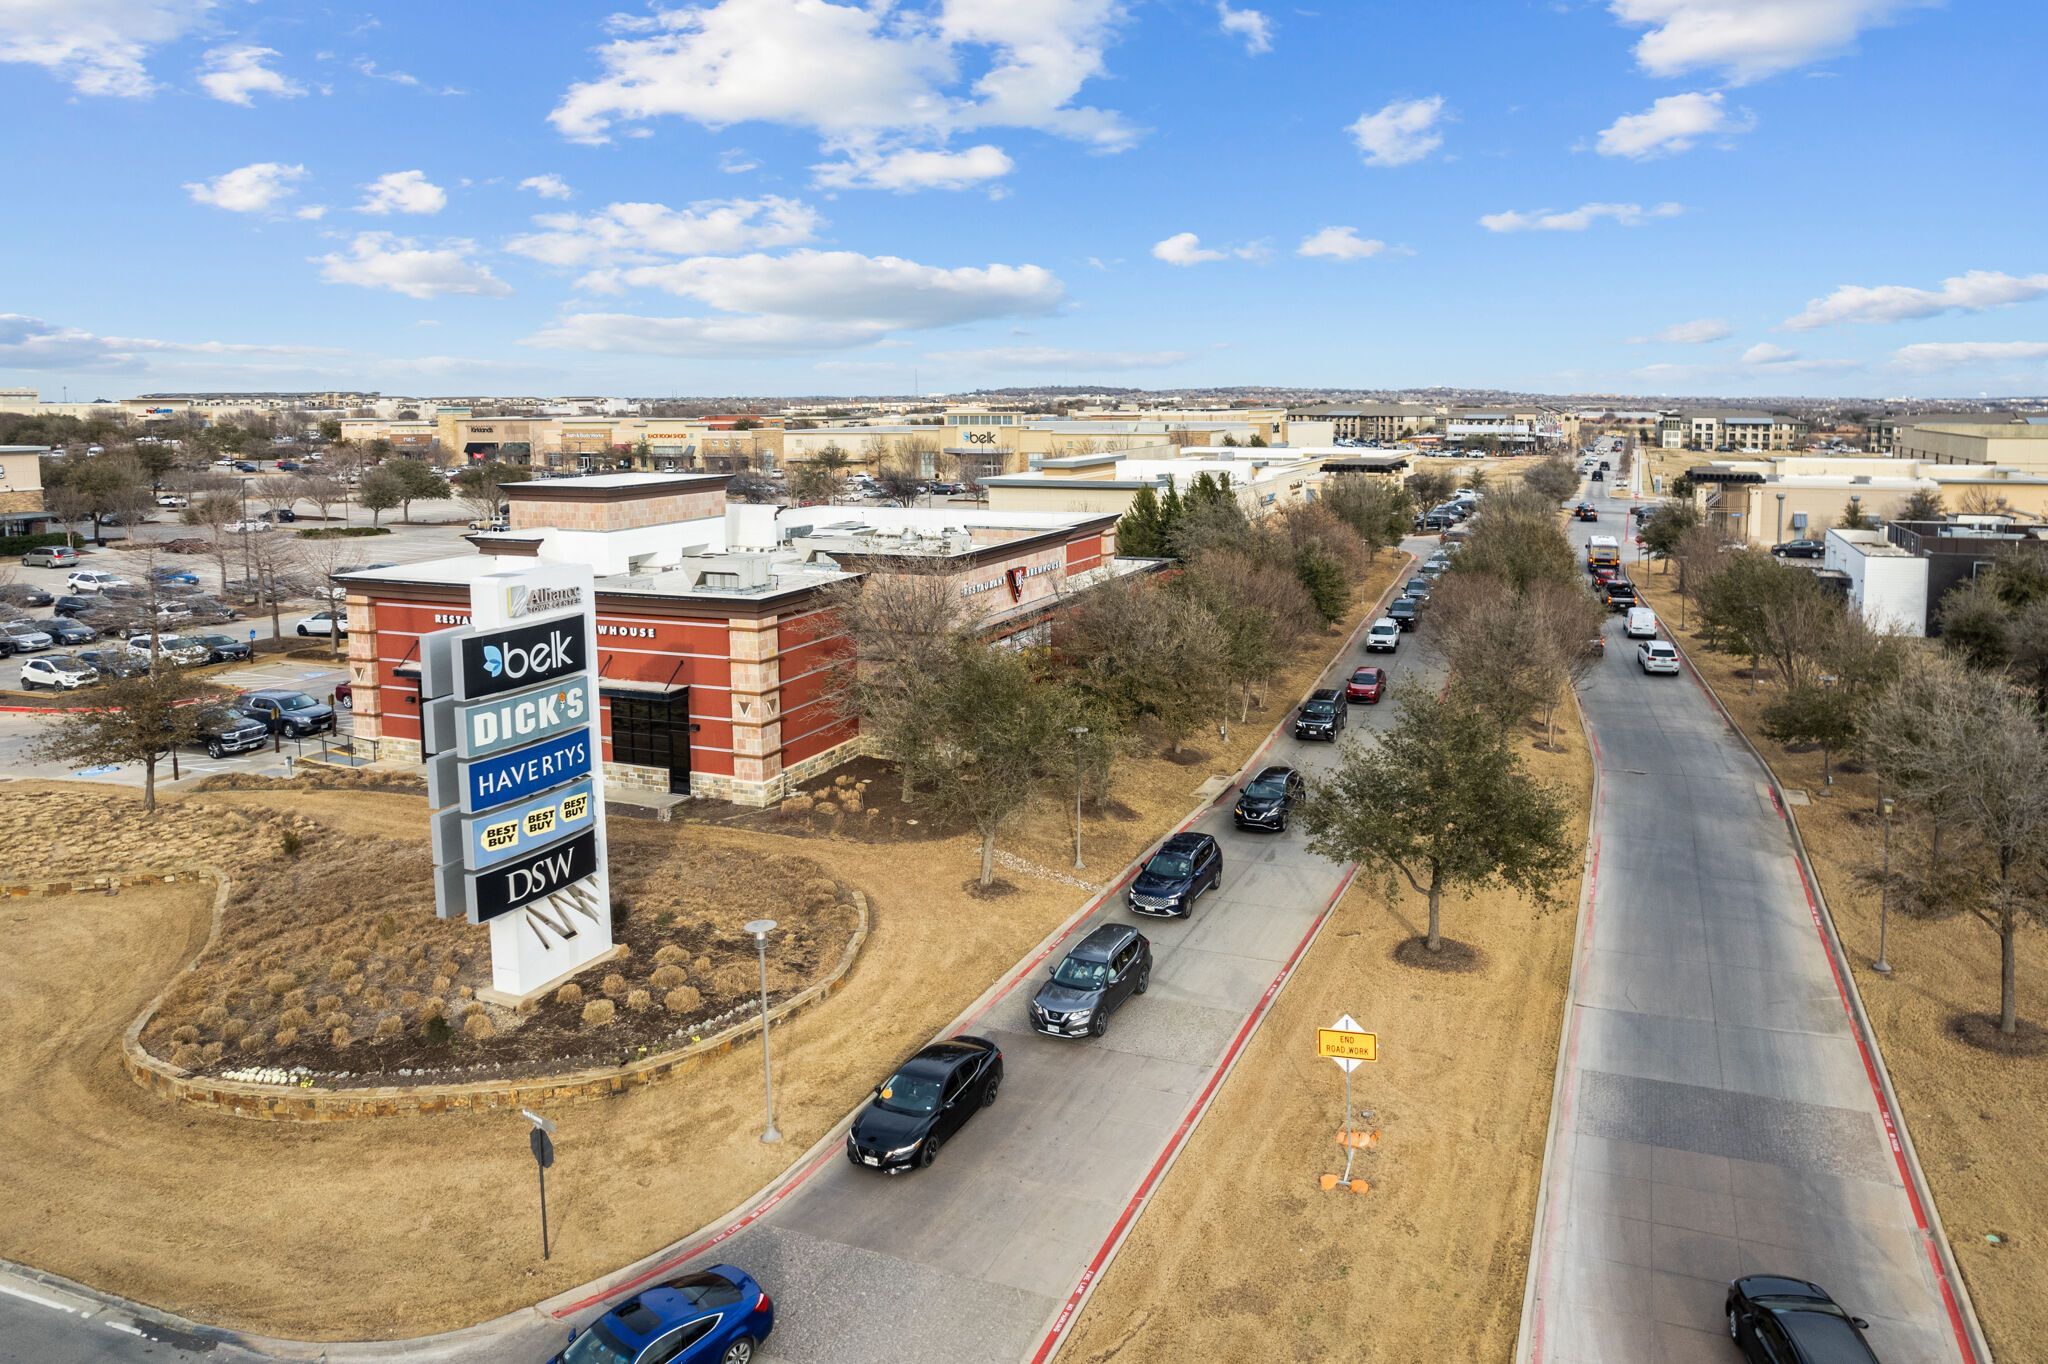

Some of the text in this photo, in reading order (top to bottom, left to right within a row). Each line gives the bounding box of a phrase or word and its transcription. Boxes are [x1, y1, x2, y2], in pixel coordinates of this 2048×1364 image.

[970, 431, 995, 444] belk
[963, 575, 1006, 595] RESTAURANT
[1026, 560, 1062, 577] BREWHOUSE
[529, 586, 581, 605] Alliance
[527, 602, 550, 613] TOWN
[434, 614, 656, 638] RESTA WHOUSE
[503, 630, 574, 679] belk
[474, 687, 584, 748] DICK'S
[479, 743, 585, 796] HAVERTYS
[564, 796, 587, 810] BEST
[528, 809, 555, 824] BEST
[565, 805, 584, 819] BUY
[487, 823, 518, 839] BEST
[529, 819, 552, 833] BUY
[488, 833, 515, 848] BUY
[505, 847, 575, 904] DSW
[1340, 1036, 1355, 1044] END
[1326, 1044, 1369, 1056] ROAD WORK
